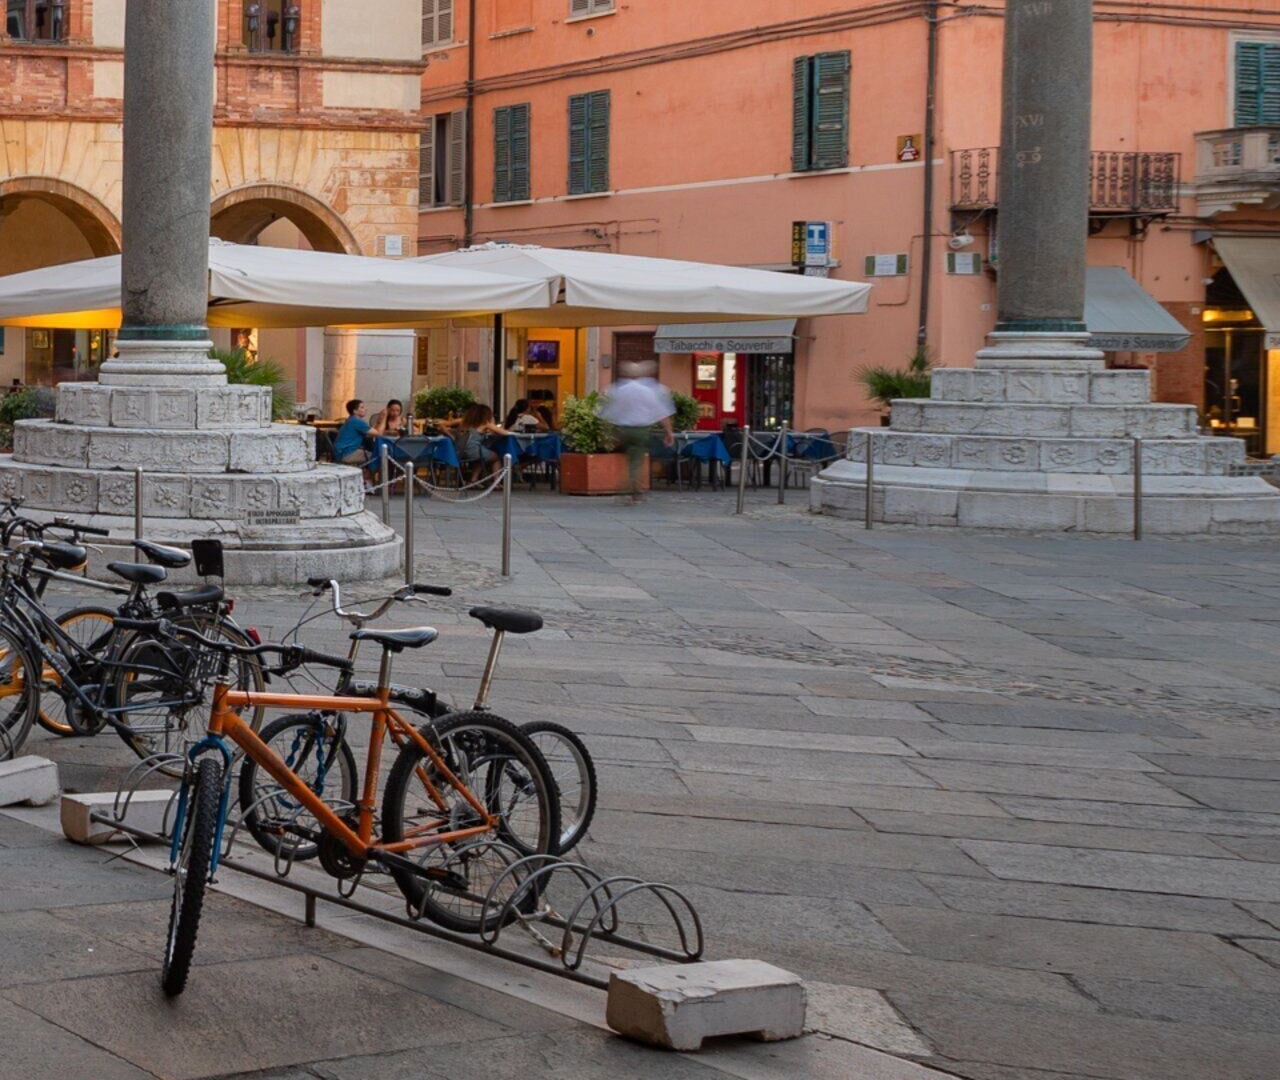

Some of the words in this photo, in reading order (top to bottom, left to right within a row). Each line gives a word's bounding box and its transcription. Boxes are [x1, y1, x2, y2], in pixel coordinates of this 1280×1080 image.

[669, 340, 713, 351] Tabacchi
[715, 342, 724, 351] e
[727, 340, 775, 351] Souvenir
[1085, 337, 1121, 348] bacchi
